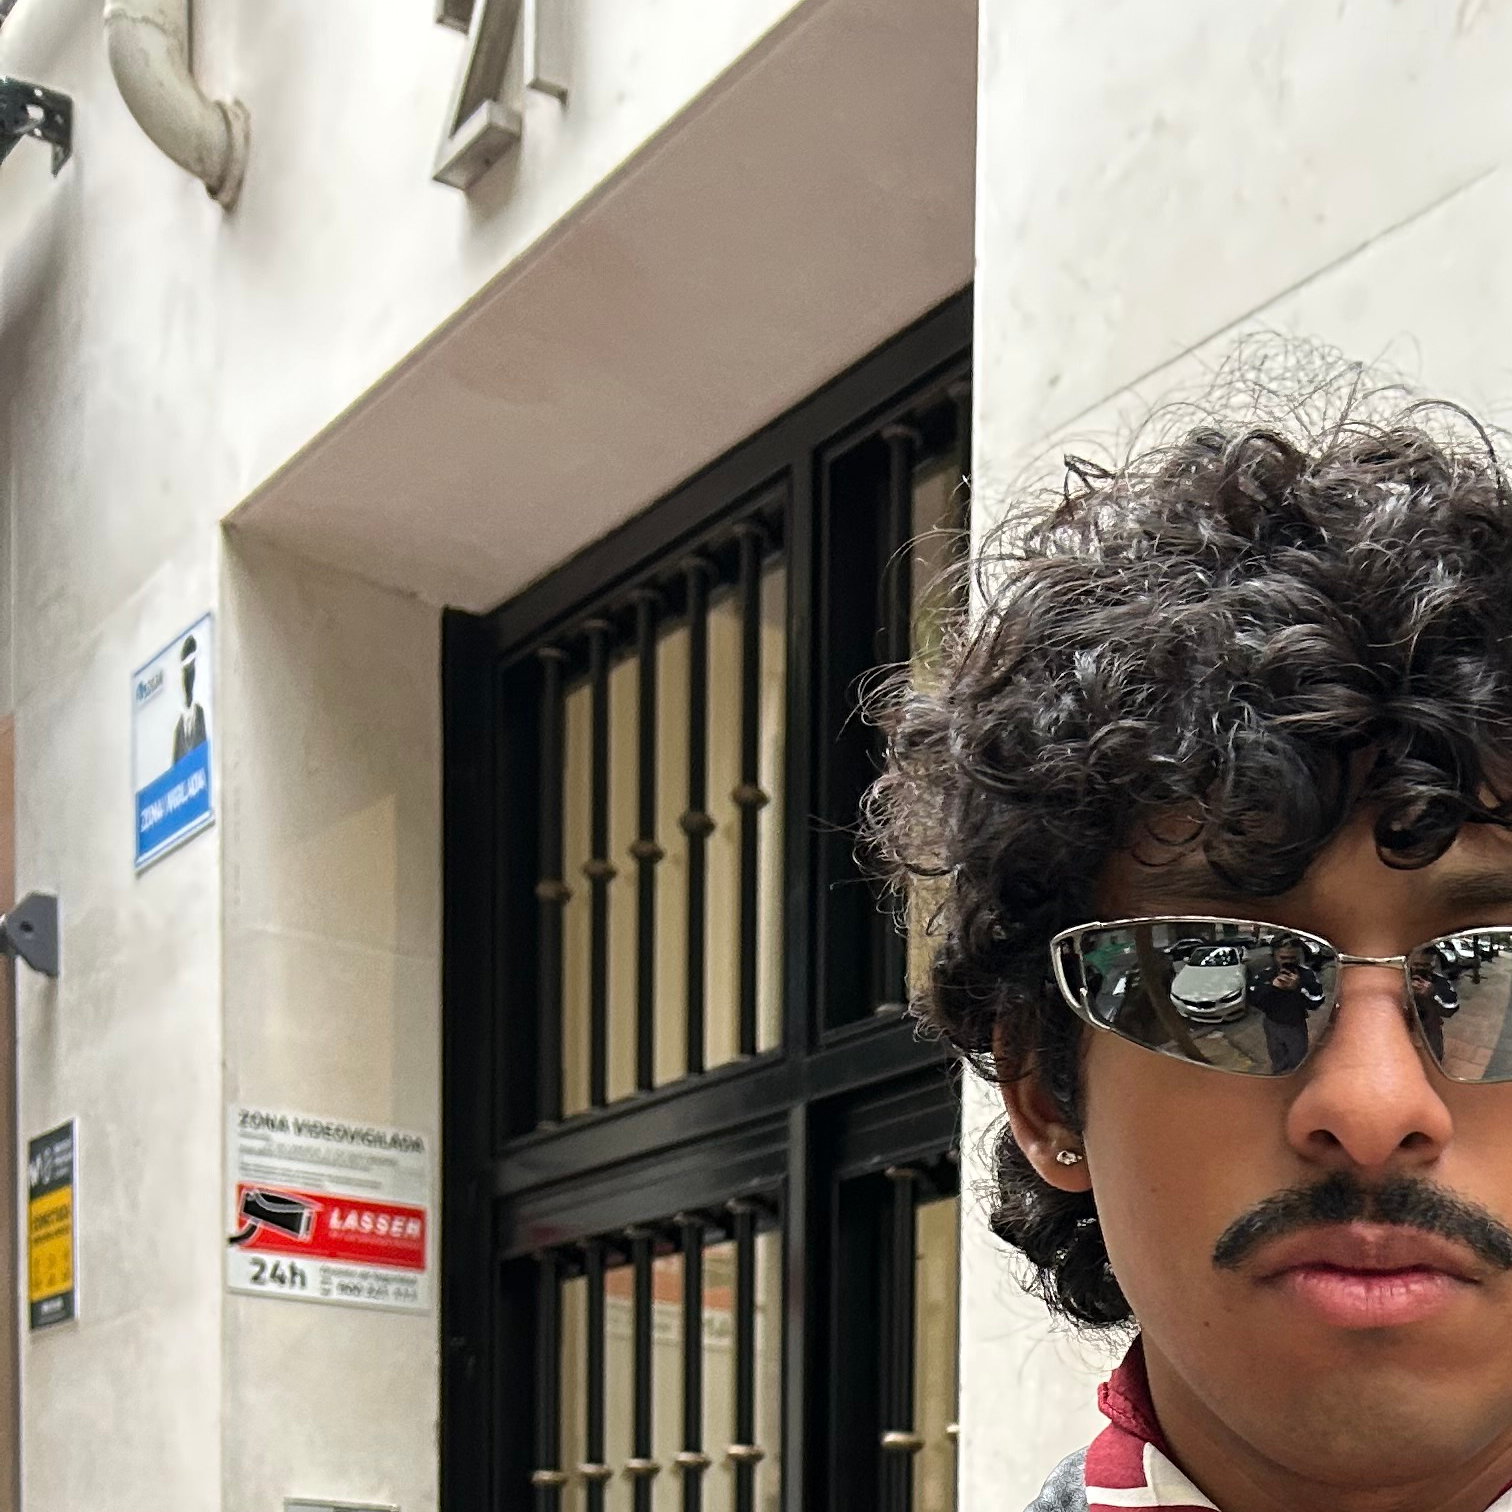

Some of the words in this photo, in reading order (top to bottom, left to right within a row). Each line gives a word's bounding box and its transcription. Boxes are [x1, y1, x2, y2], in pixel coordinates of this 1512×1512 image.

[239, 1109, 289, 1133] ZONA
[293, 1116, 425, 1154] VIDEOVIGILADA
[328, 1207, 422, 1239] LASSER
[249, 1257, 307, 1290] 24h
